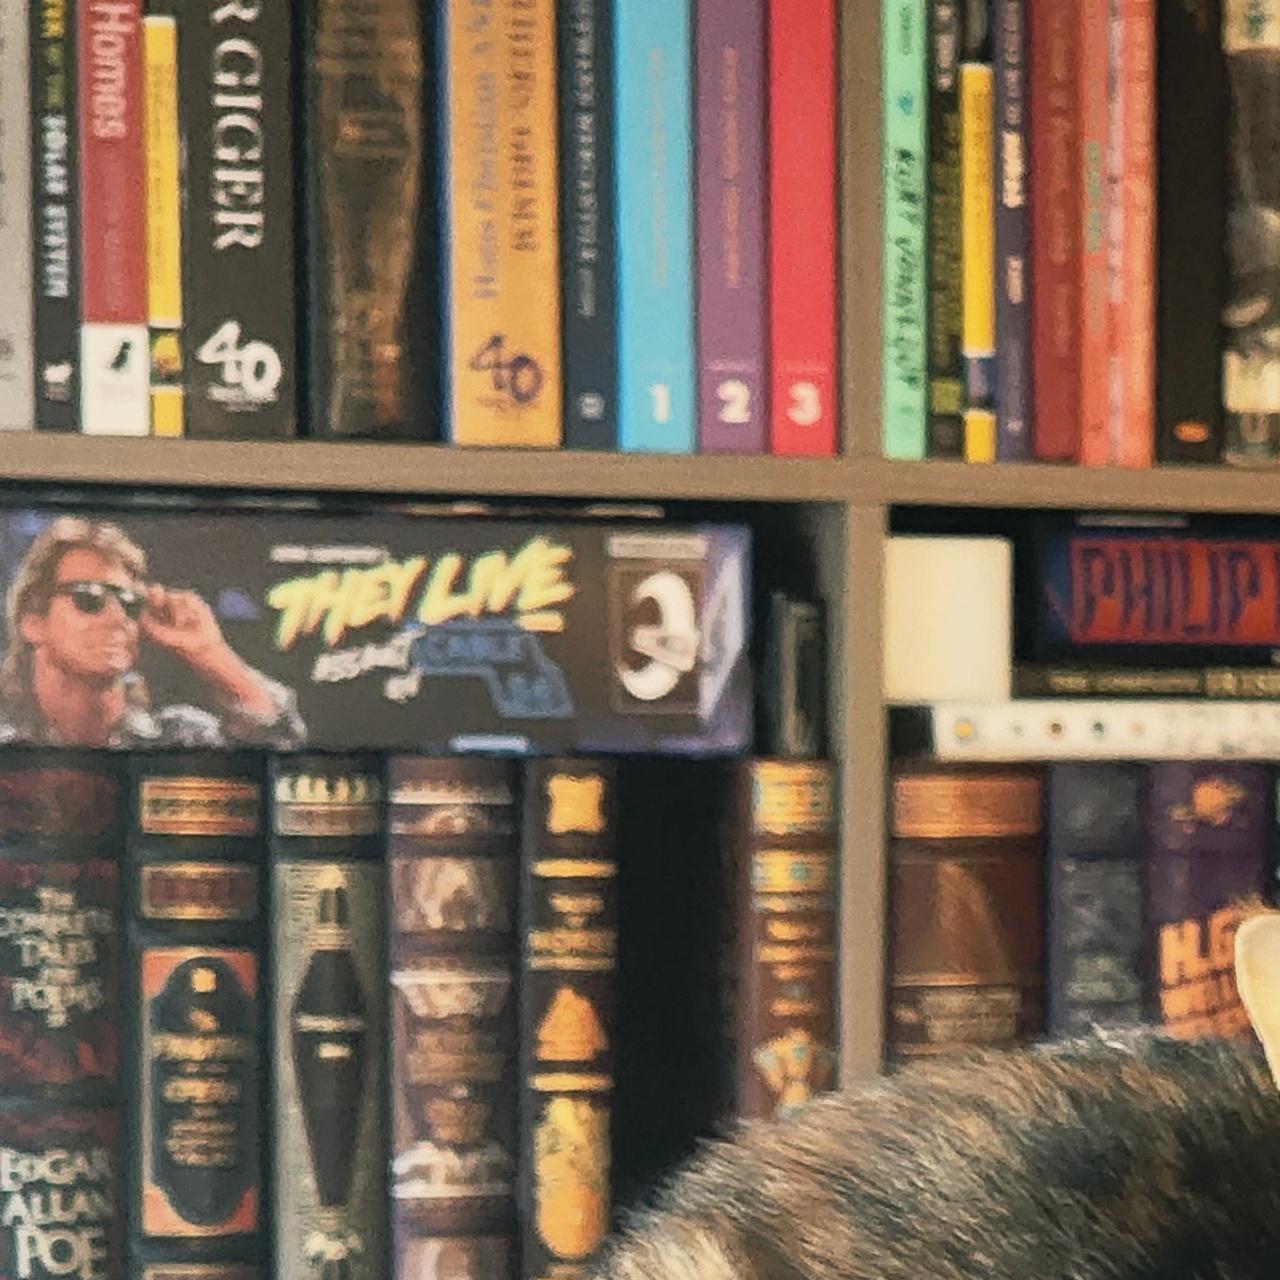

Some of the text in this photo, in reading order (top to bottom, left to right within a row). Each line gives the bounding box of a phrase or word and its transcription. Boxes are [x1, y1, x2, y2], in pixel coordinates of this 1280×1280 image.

[210, 38, 264, 250] GIGER
[649, 383, 672, 423] 1
[716, 380, 751, 423] 2
[787, 381, 822, 426] 3
[268, 537, 577, 651] THEY LIVE
[1080, 548, 1260, 635] PHILIP
